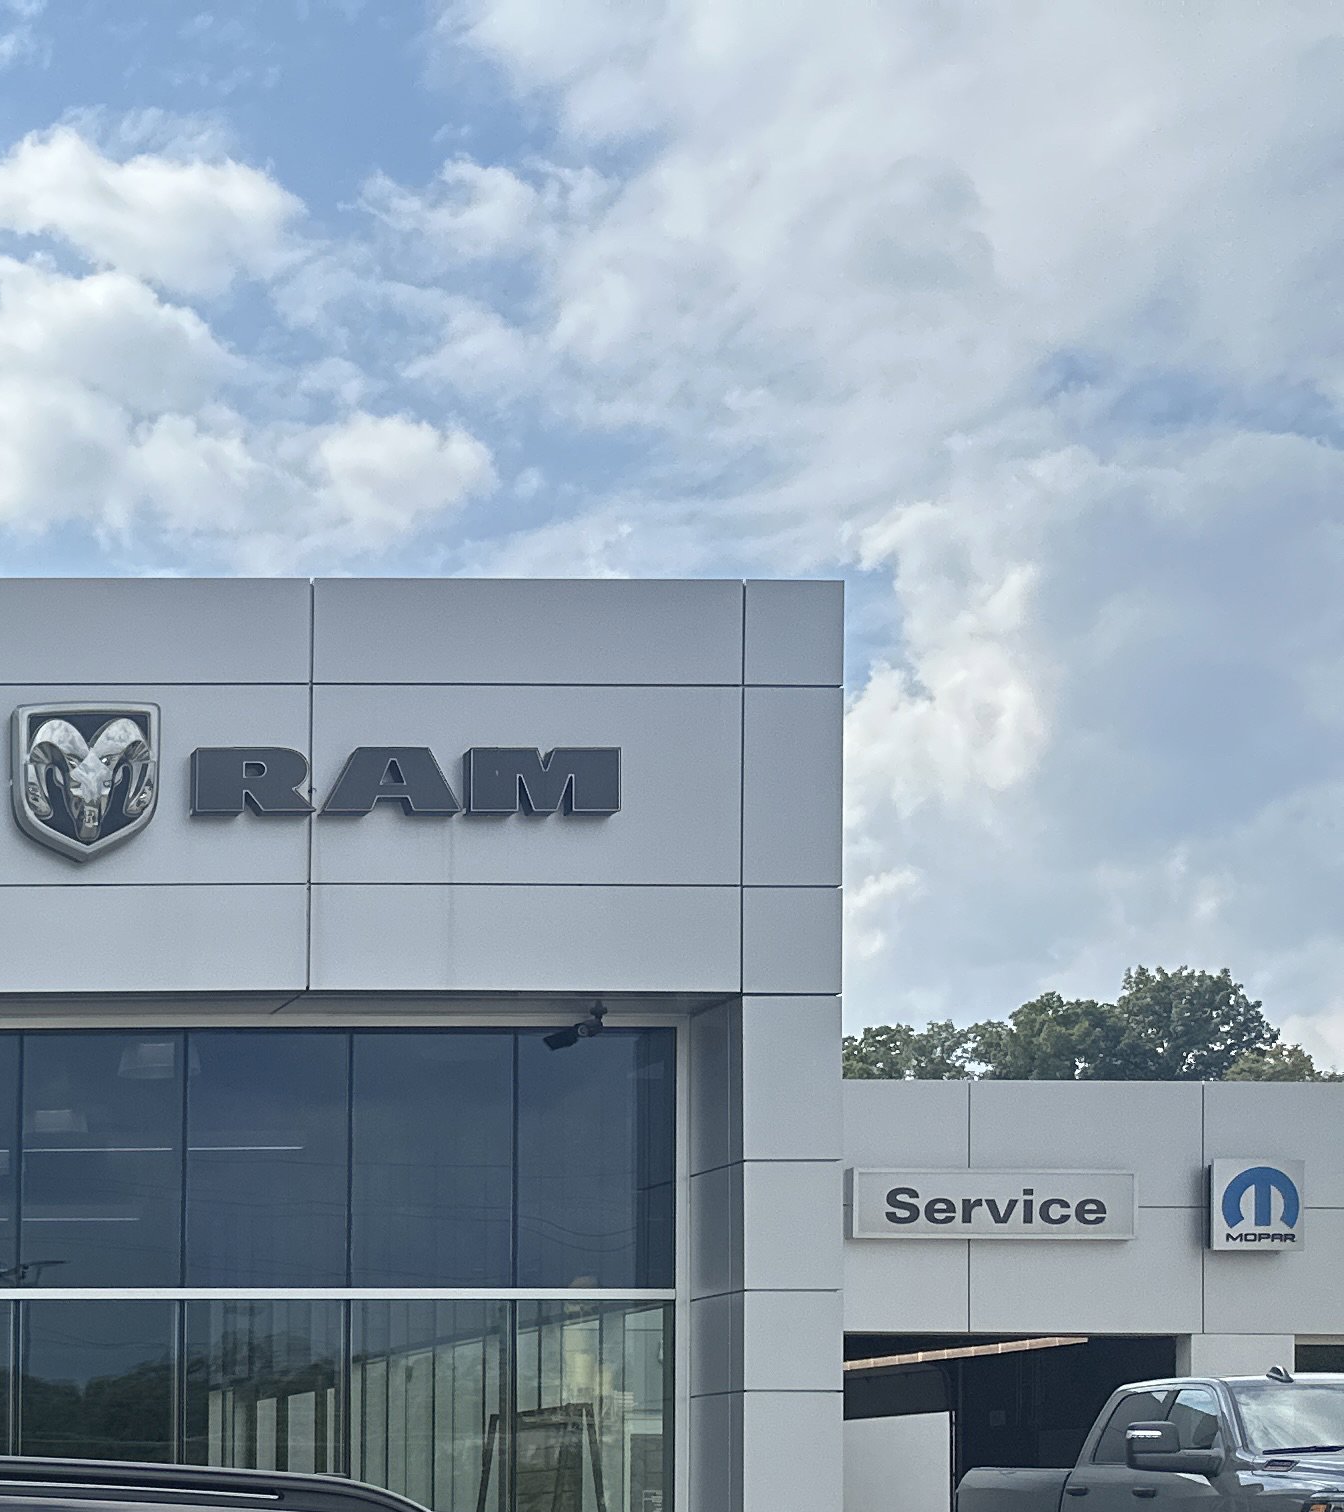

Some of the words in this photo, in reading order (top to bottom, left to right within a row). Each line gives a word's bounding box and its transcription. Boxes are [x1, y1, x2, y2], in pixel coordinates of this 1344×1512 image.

[190, 746, 622, 816] RAM
[885, 1187, 1108, 1225] Service
[1225, 1233, 1296, 1243] MOPAR
